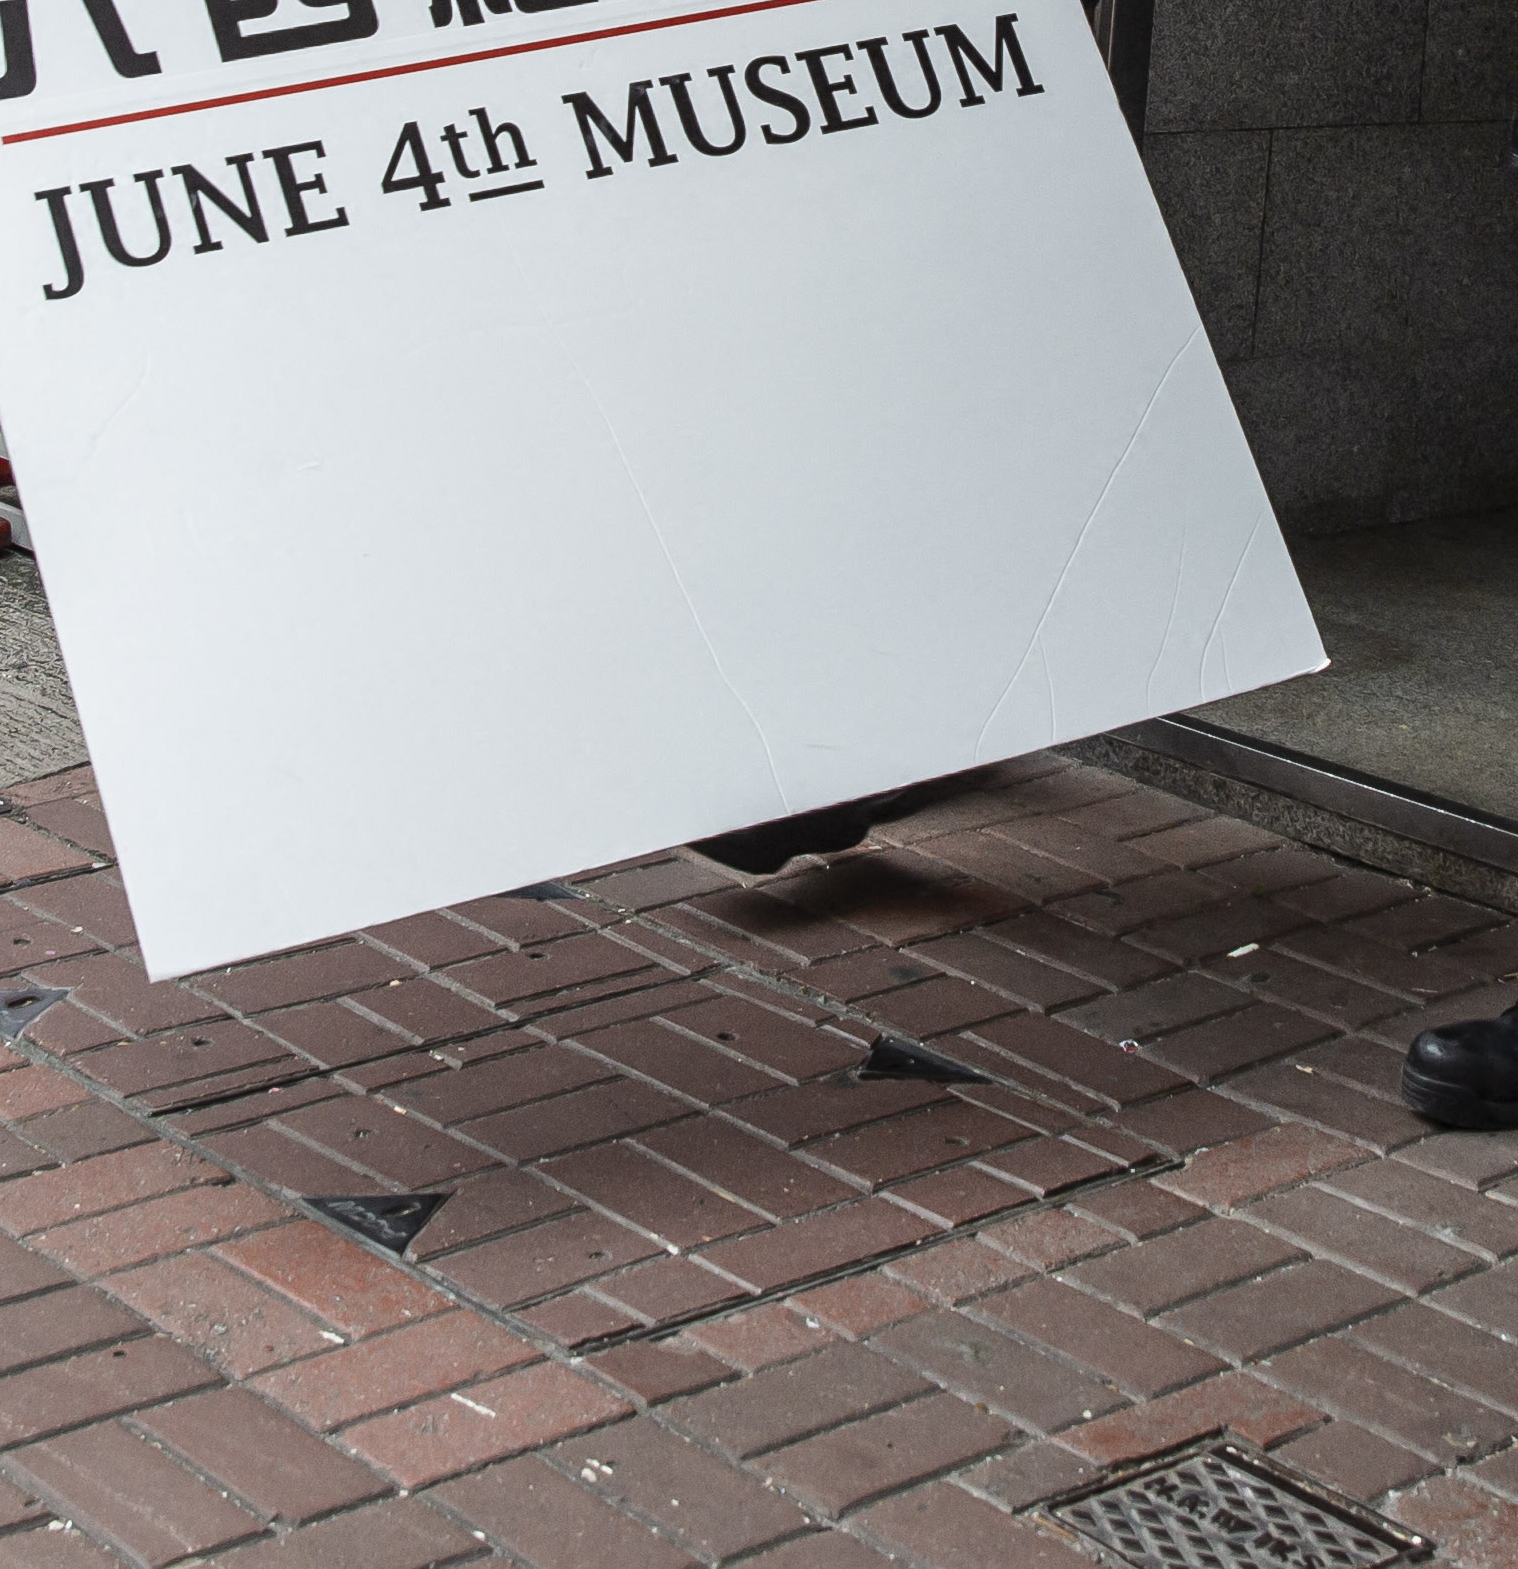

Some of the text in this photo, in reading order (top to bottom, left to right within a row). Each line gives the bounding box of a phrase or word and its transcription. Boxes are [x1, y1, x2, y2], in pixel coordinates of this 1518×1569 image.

[33, 13, 1045, 301] JUNE 4th MUSEUM
